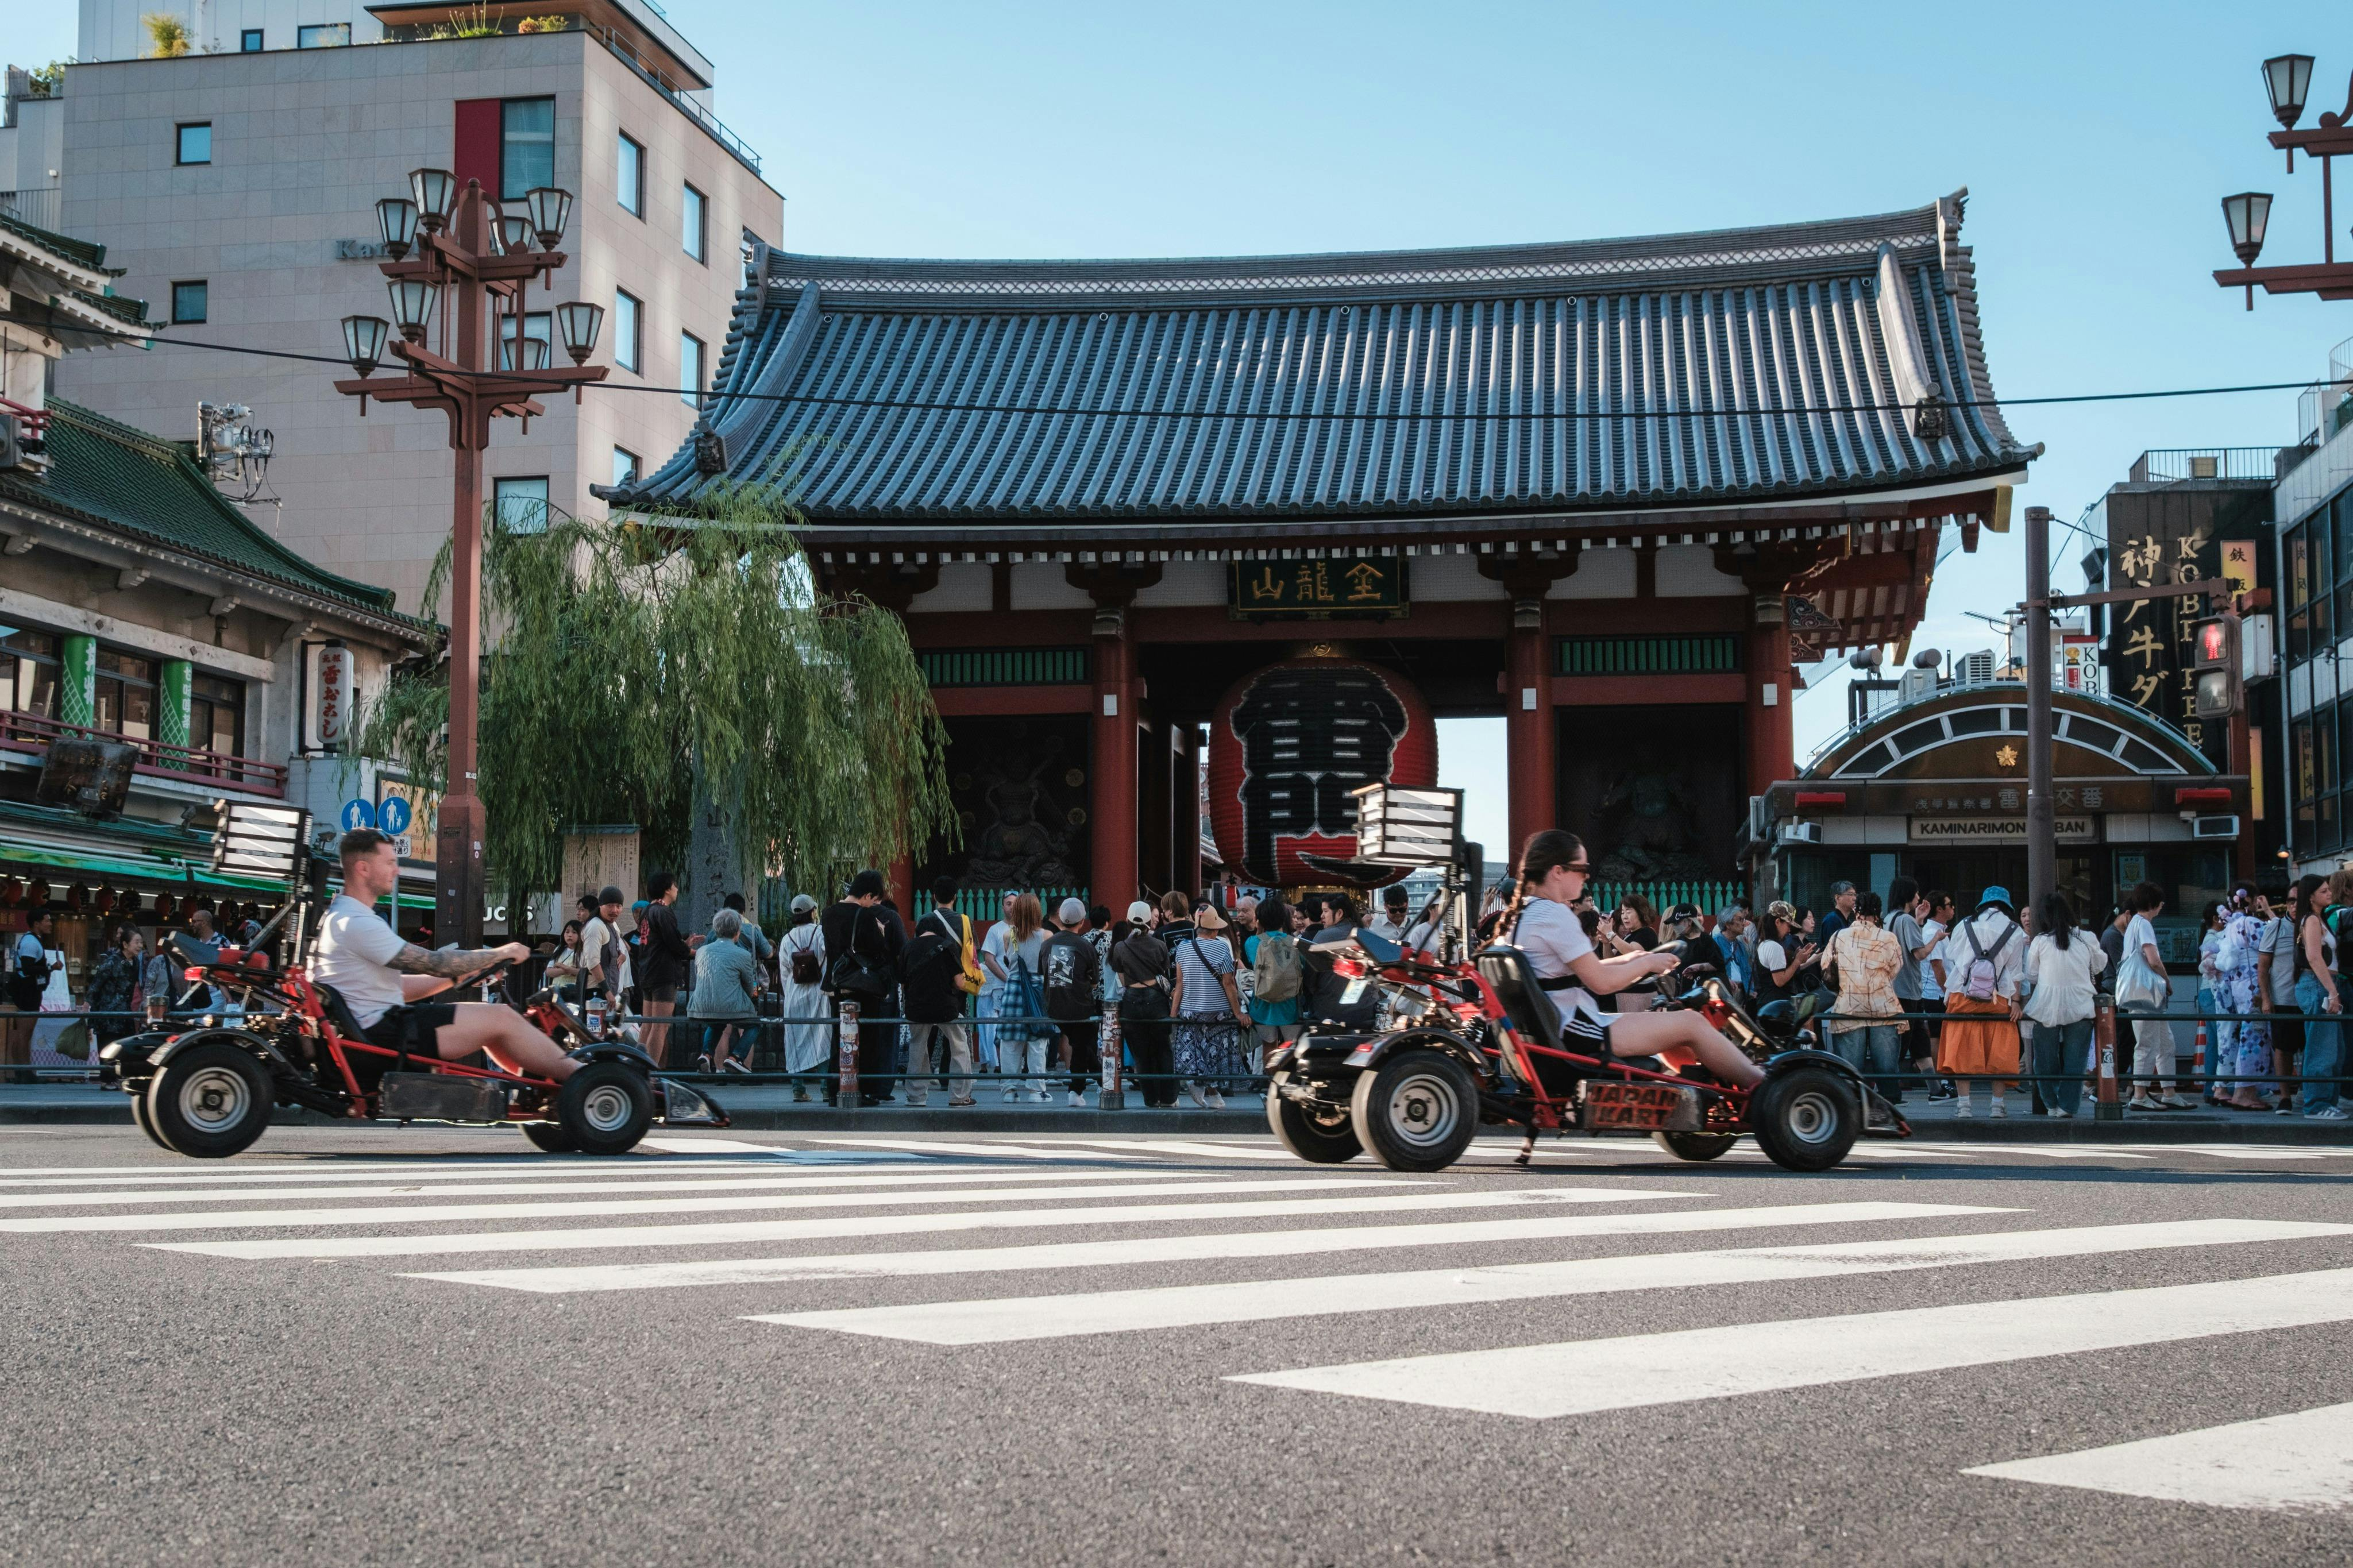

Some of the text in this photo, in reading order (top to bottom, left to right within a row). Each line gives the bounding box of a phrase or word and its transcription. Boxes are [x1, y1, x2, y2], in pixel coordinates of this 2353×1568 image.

[2120, 535, 2169, 718] 神戸牛ダ
[2083, 647, 2097, 694] KOB
[322, 665, 341, 738] 雷おこし
[1999, 788, 2104, 809] 雷交番
[1920, 821, 2085, 835] KAMINARIMON BAN
[395, 839, 409, 847] を除く
[1589, 1085, 1681, 1109] JAPAN
[1596, 1106, 1671, 1127] KART
